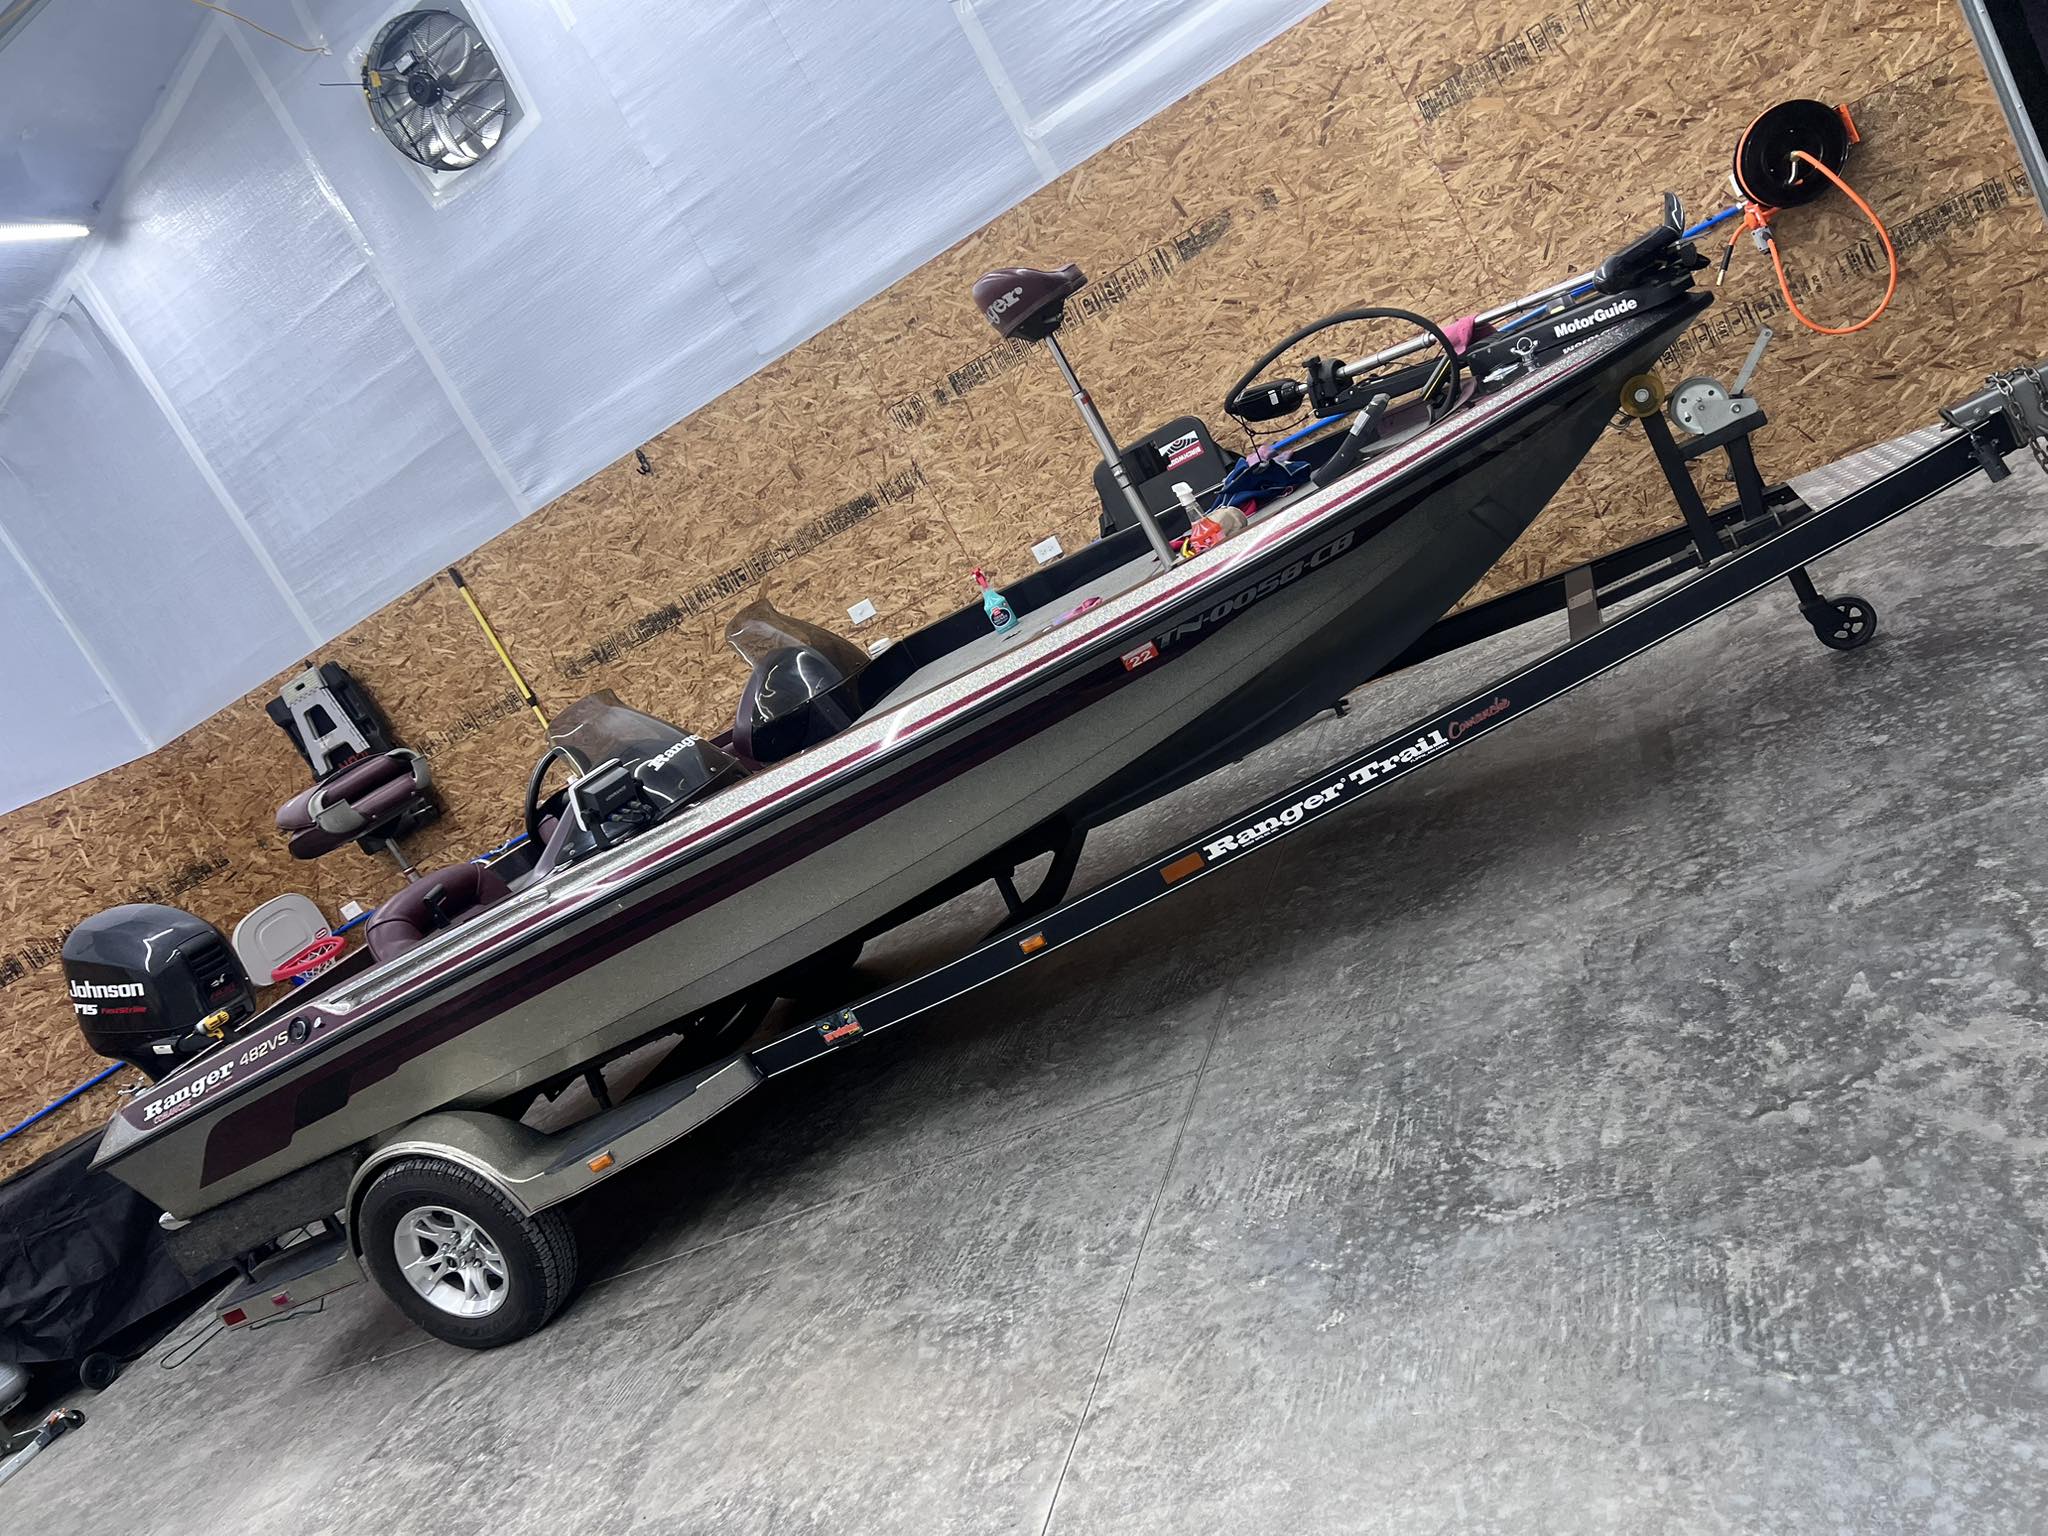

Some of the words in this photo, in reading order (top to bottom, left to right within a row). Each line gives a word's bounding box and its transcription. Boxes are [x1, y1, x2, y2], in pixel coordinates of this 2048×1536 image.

[1554, 299, 1637, 338] MotorGuide
[1130, 650, 1153, 667] 22
[1203, 781, 1344, 860] Ranger
[1349, 730, 1448, 786] Trail
[70, 980, 144, 998] Johnson
[144, 1061, 234, 1121] Ranger
[240, 1031, 288, 1065] 482VS
